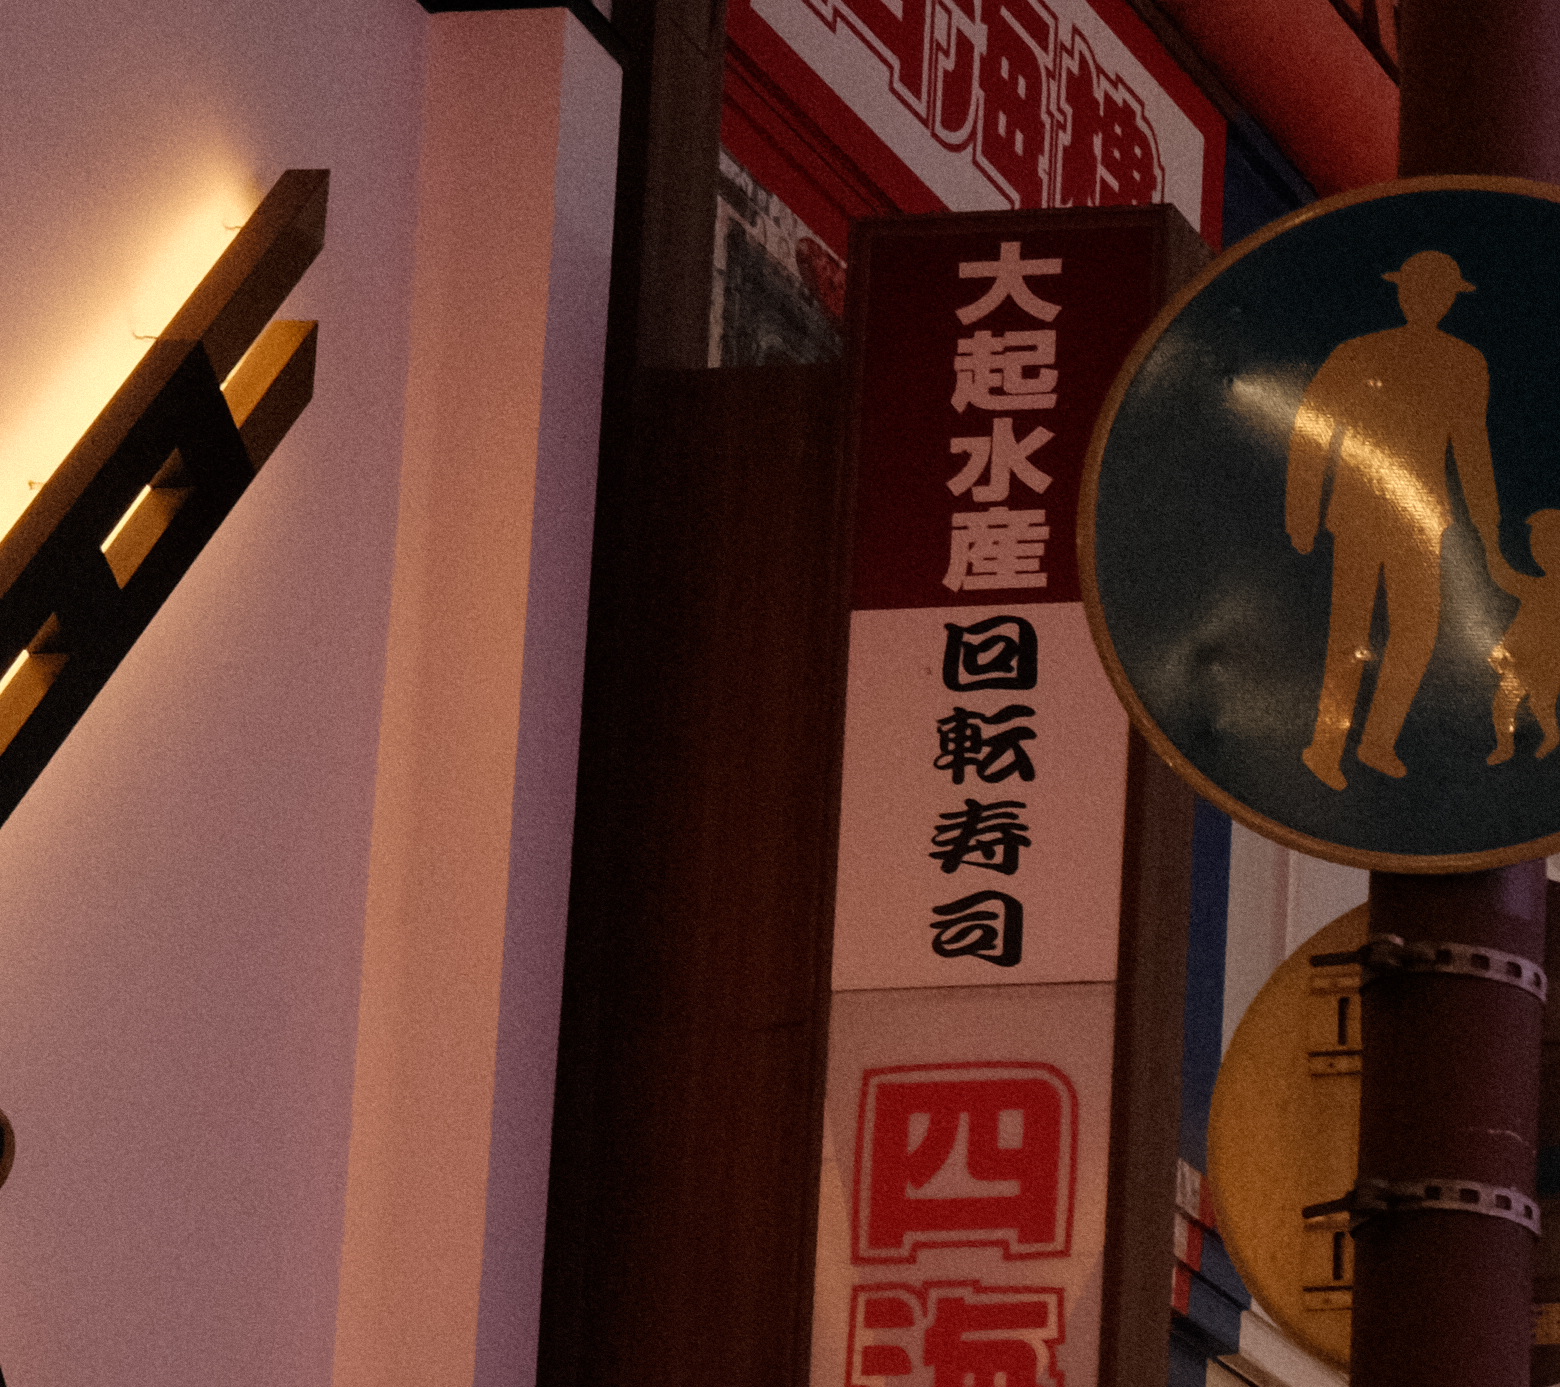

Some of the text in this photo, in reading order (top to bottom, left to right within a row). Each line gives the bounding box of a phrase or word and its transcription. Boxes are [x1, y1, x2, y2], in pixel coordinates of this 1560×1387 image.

[940, 242, 1063, 593] 大起水産
[927, 614, 1038, 968] 回転寿司
